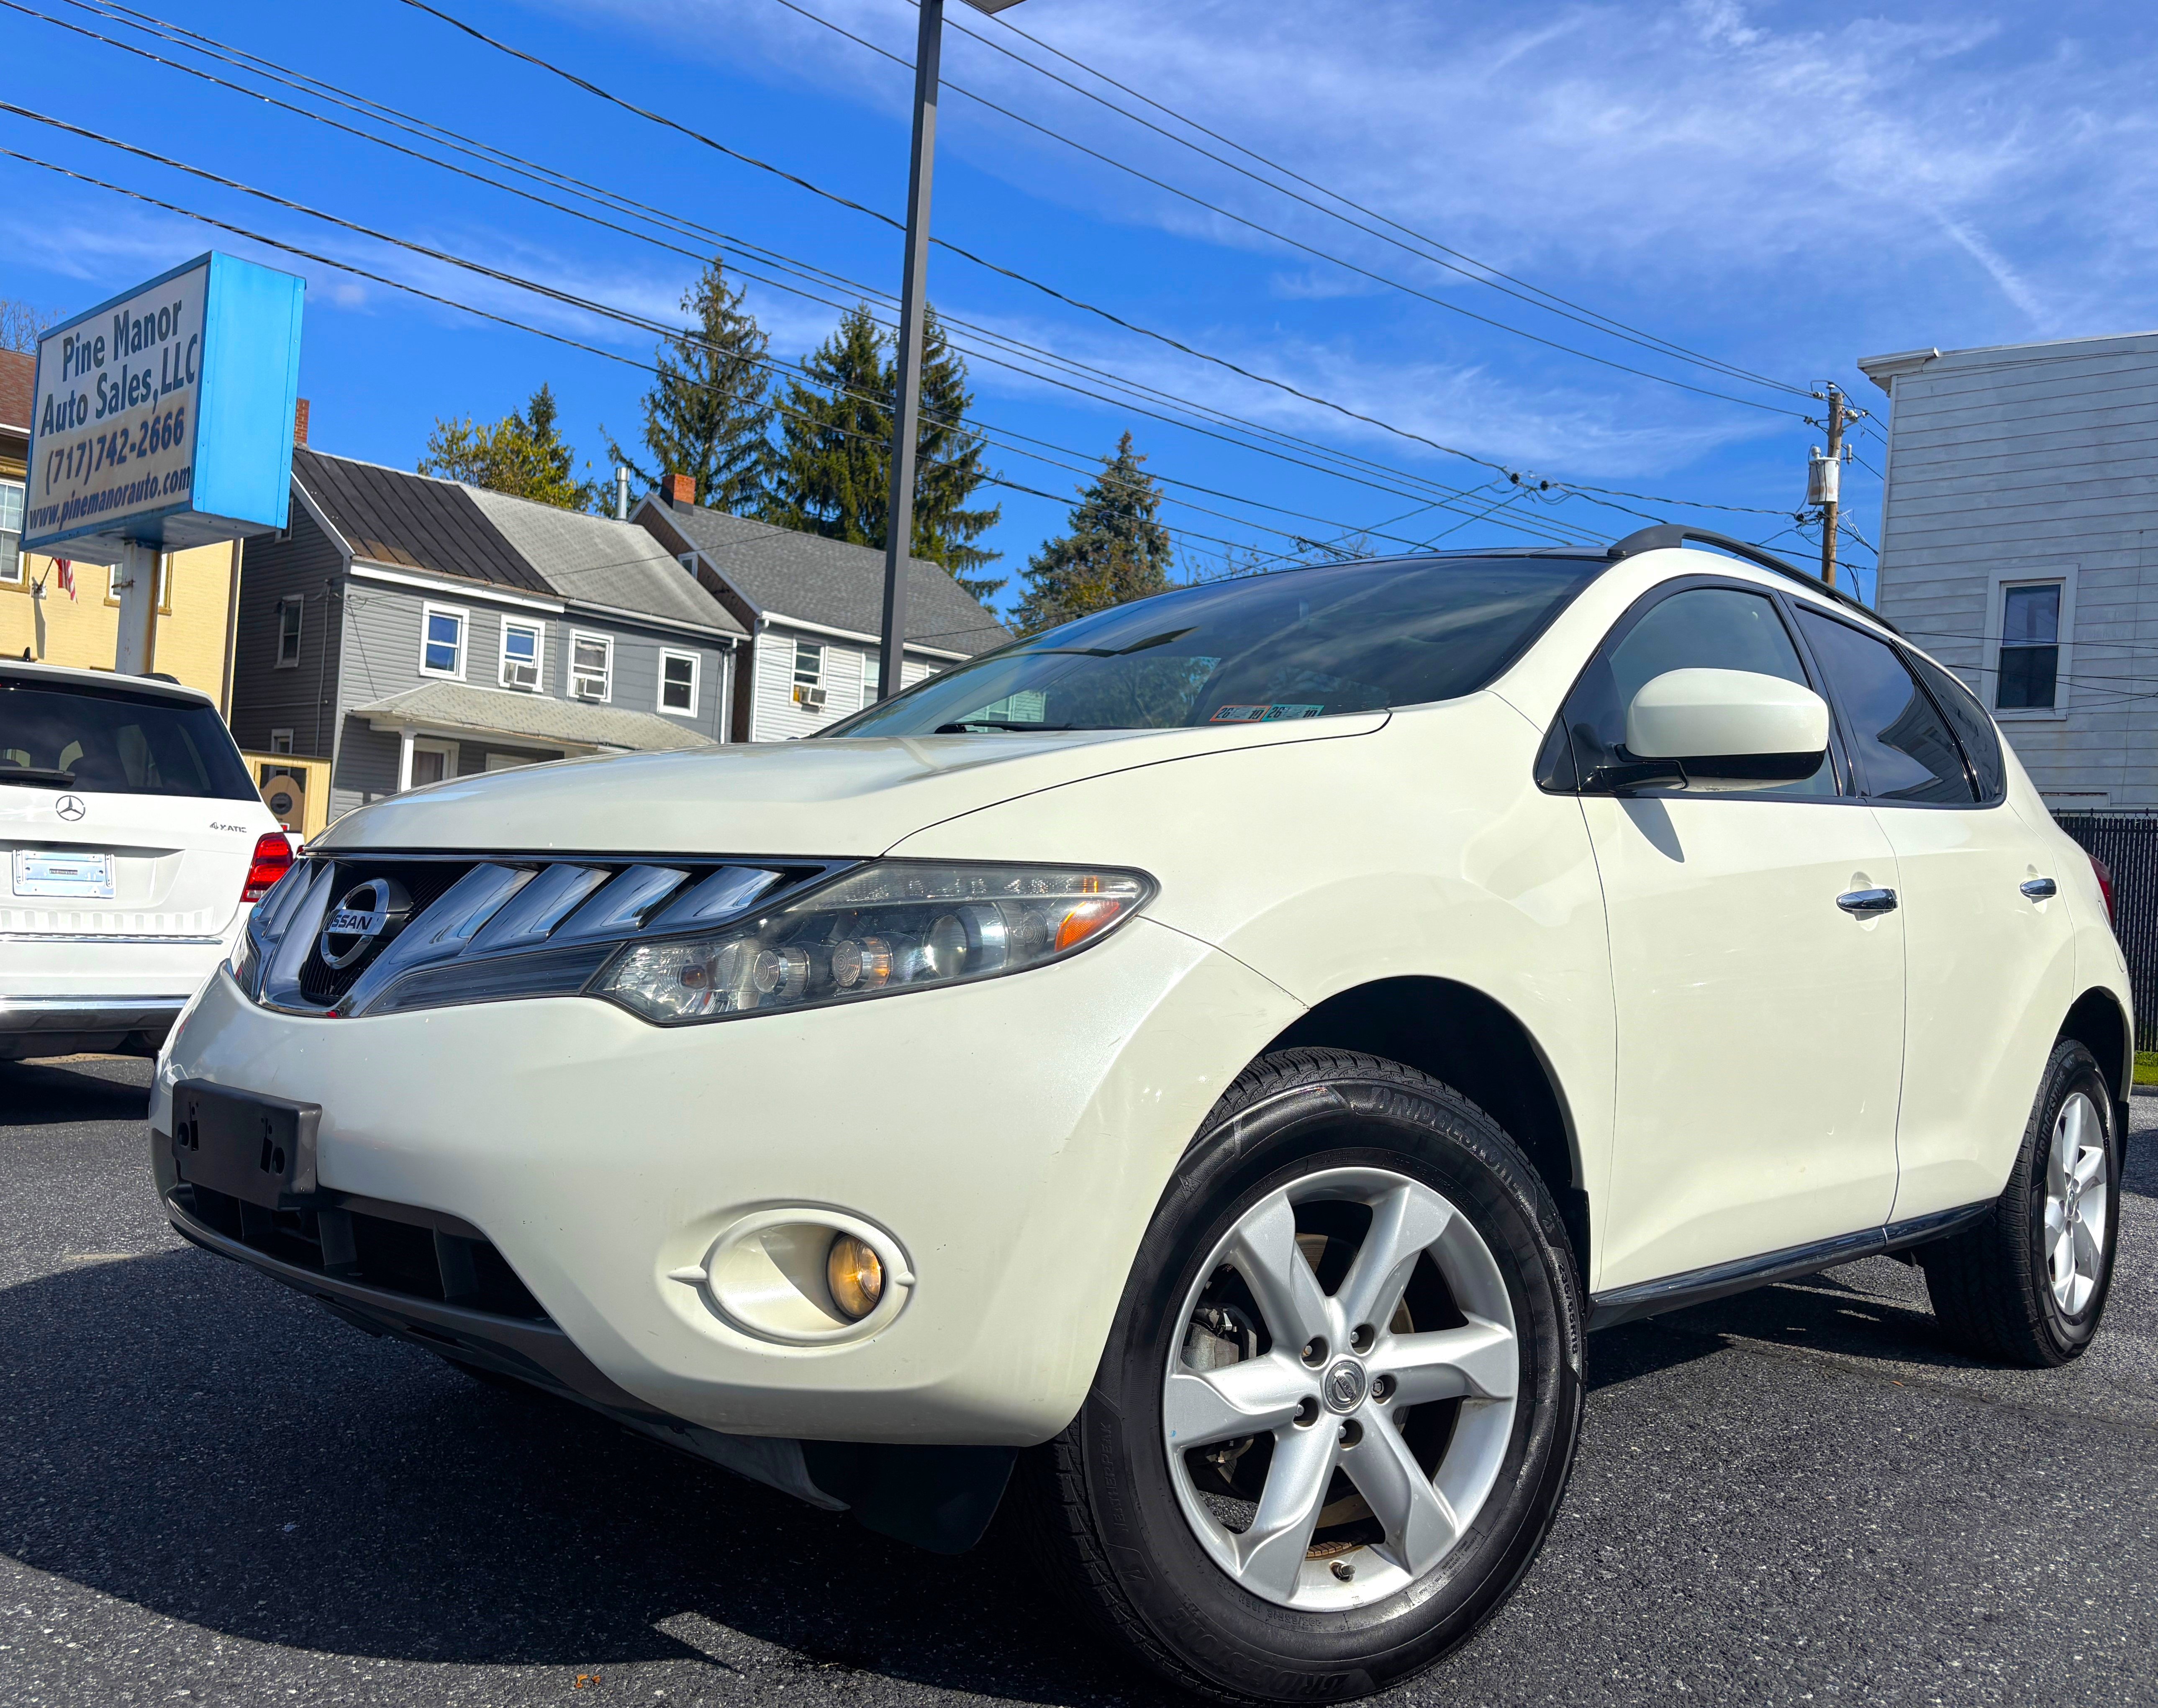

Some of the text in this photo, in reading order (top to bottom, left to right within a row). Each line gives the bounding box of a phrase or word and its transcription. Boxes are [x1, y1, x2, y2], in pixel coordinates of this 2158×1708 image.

[63, 300, 182, 382] Pine Manor
[40, 390, 88, 438] Auto
[30, 466, 190, 531] www.pinemanorauto.com
